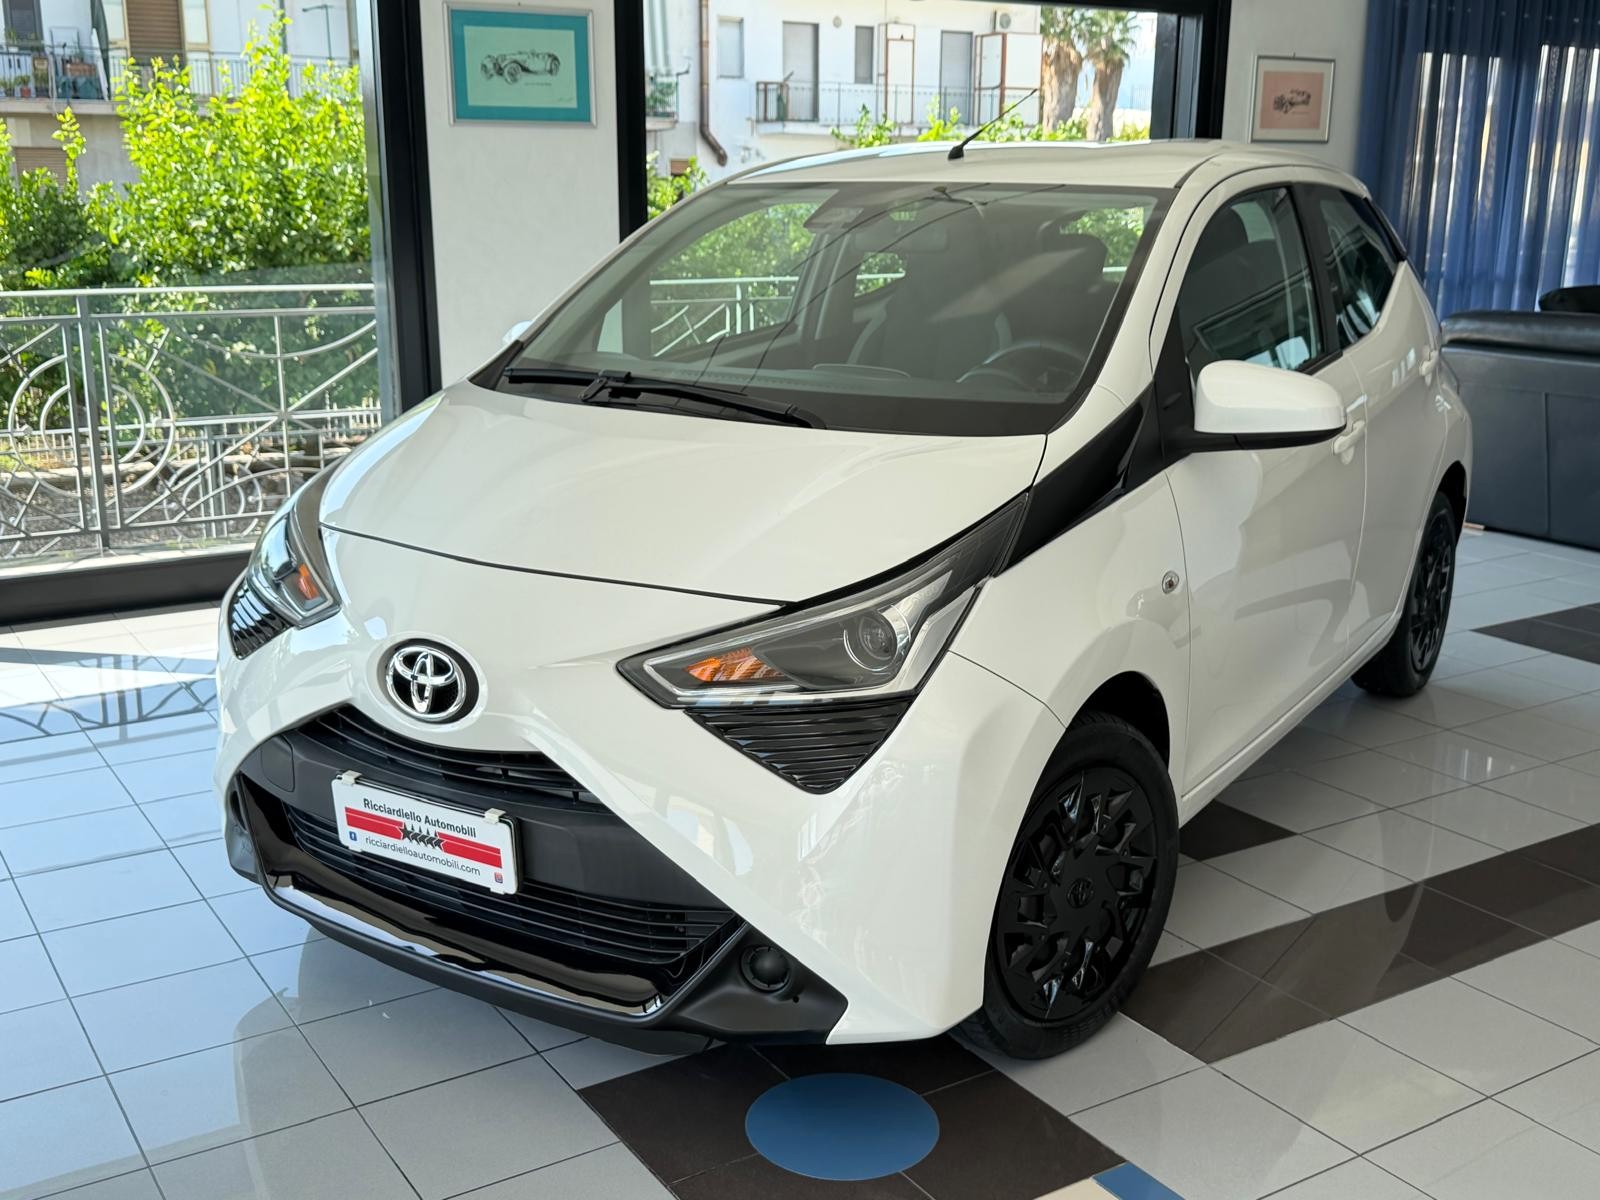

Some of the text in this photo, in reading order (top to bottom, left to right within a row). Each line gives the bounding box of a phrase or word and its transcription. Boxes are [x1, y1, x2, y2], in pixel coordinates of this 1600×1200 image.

[363, 798, 476, 838] Ricciardiello Automobili
[365, 836, 481, 876] ricciardielloautomobili.com
